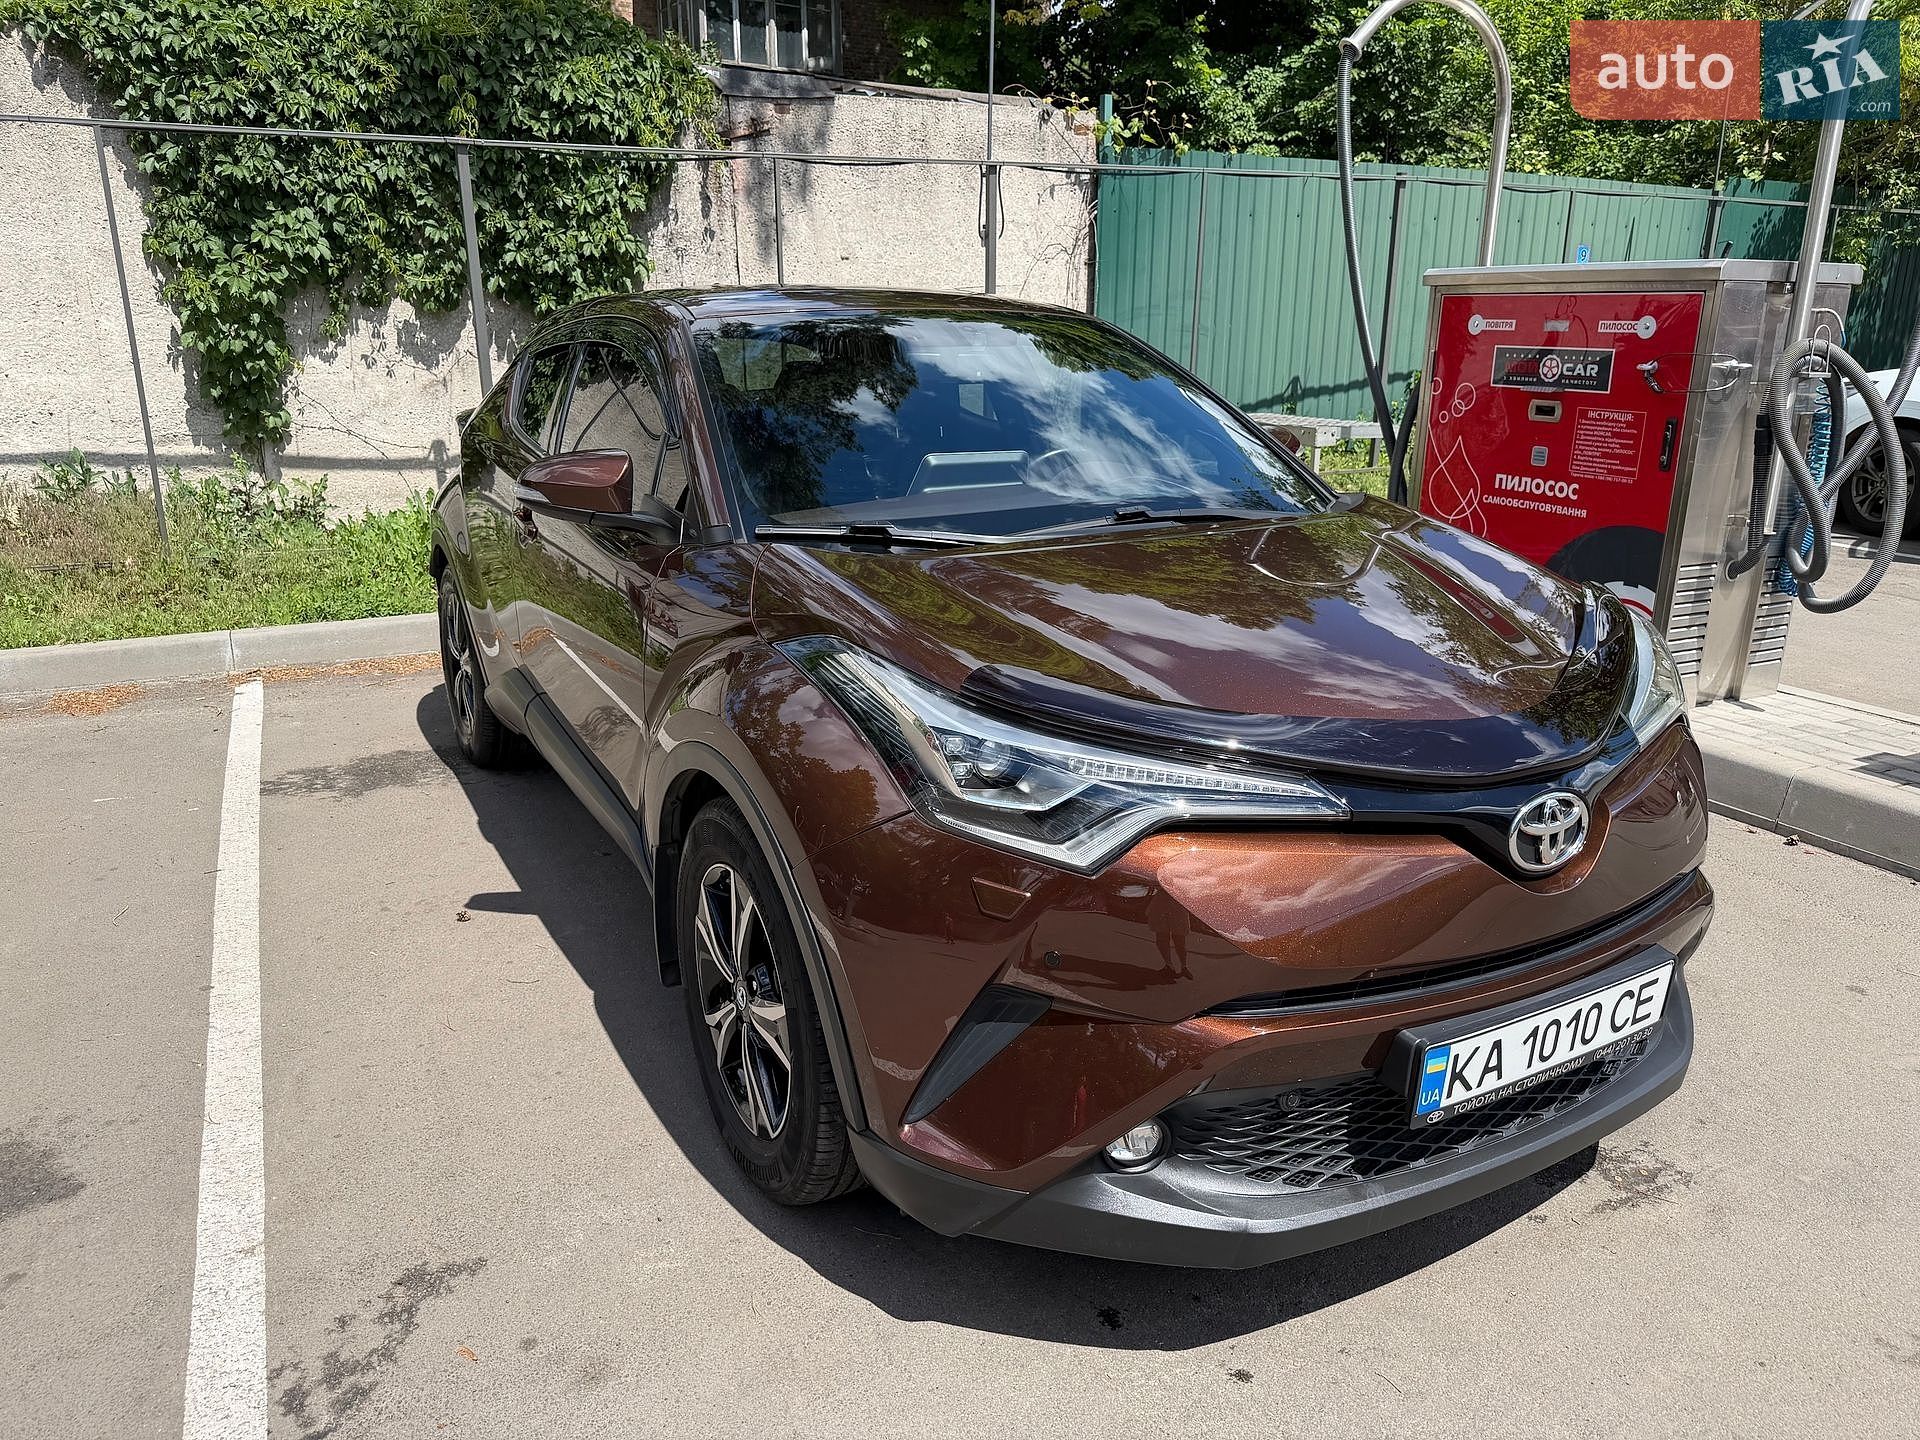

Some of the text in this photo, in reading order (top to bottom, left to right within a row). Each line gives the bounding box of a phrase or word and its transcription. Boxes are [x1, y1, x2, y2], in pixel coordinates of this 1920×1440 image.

[1485, 321, 1513, 329] ПОВІТРЯ
[1599, 322, 1638, 331] ПИЛОСОС
[1562, 363, 1599, 377] CAR
[1588, 410, 1634, 422] ІНСТРУКЦІЯ:
[1494, 474, 1579, 500] ПИЛОСОС
[1482, 494, 1587, 518] САМООБСЛУГОВУВАННЯ
[1445, 977, 1660, 1099] KA 1010 CE
[1453, 1095, 1498, 1115] ТОЙОТА
[1498, 1086, 1513, 1099] НА
[1514, 1057, 1586, 1092] СТОЛИЧНОМУ
[1421, 1090, 1440, 1106] UA
